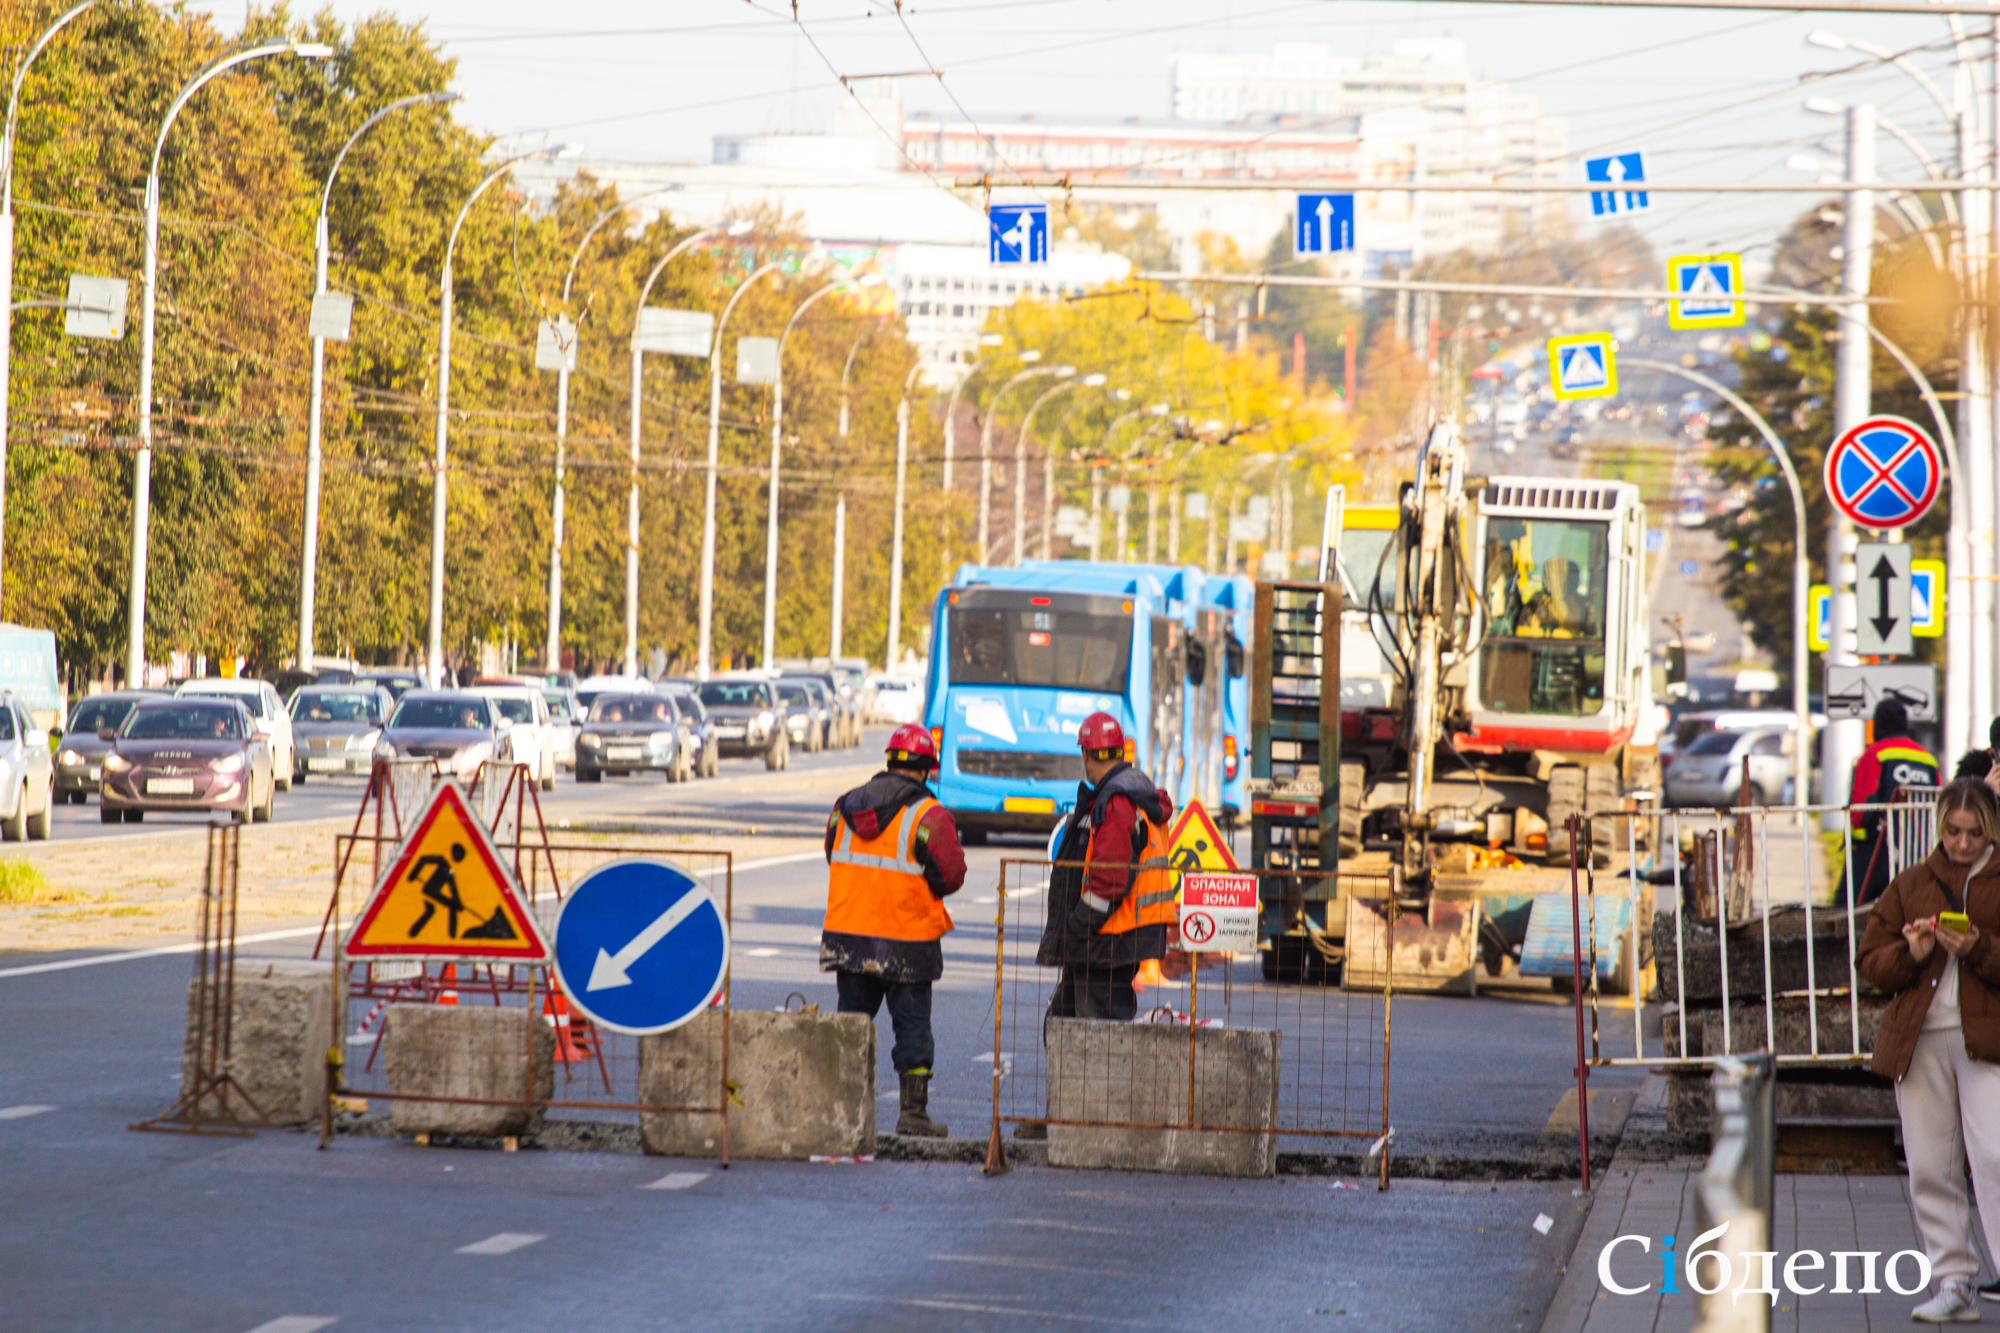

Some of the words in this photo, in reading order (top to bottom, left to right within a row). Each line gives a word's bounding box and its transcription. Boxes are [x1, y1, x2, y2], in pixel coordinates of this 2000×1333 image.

[1190, 878, 1250, 892] ОПАСНАЯ
[1202, 892, 1240, 906] ЗОНА!
[1223, 917, 1250, 926] ПРОХОД
